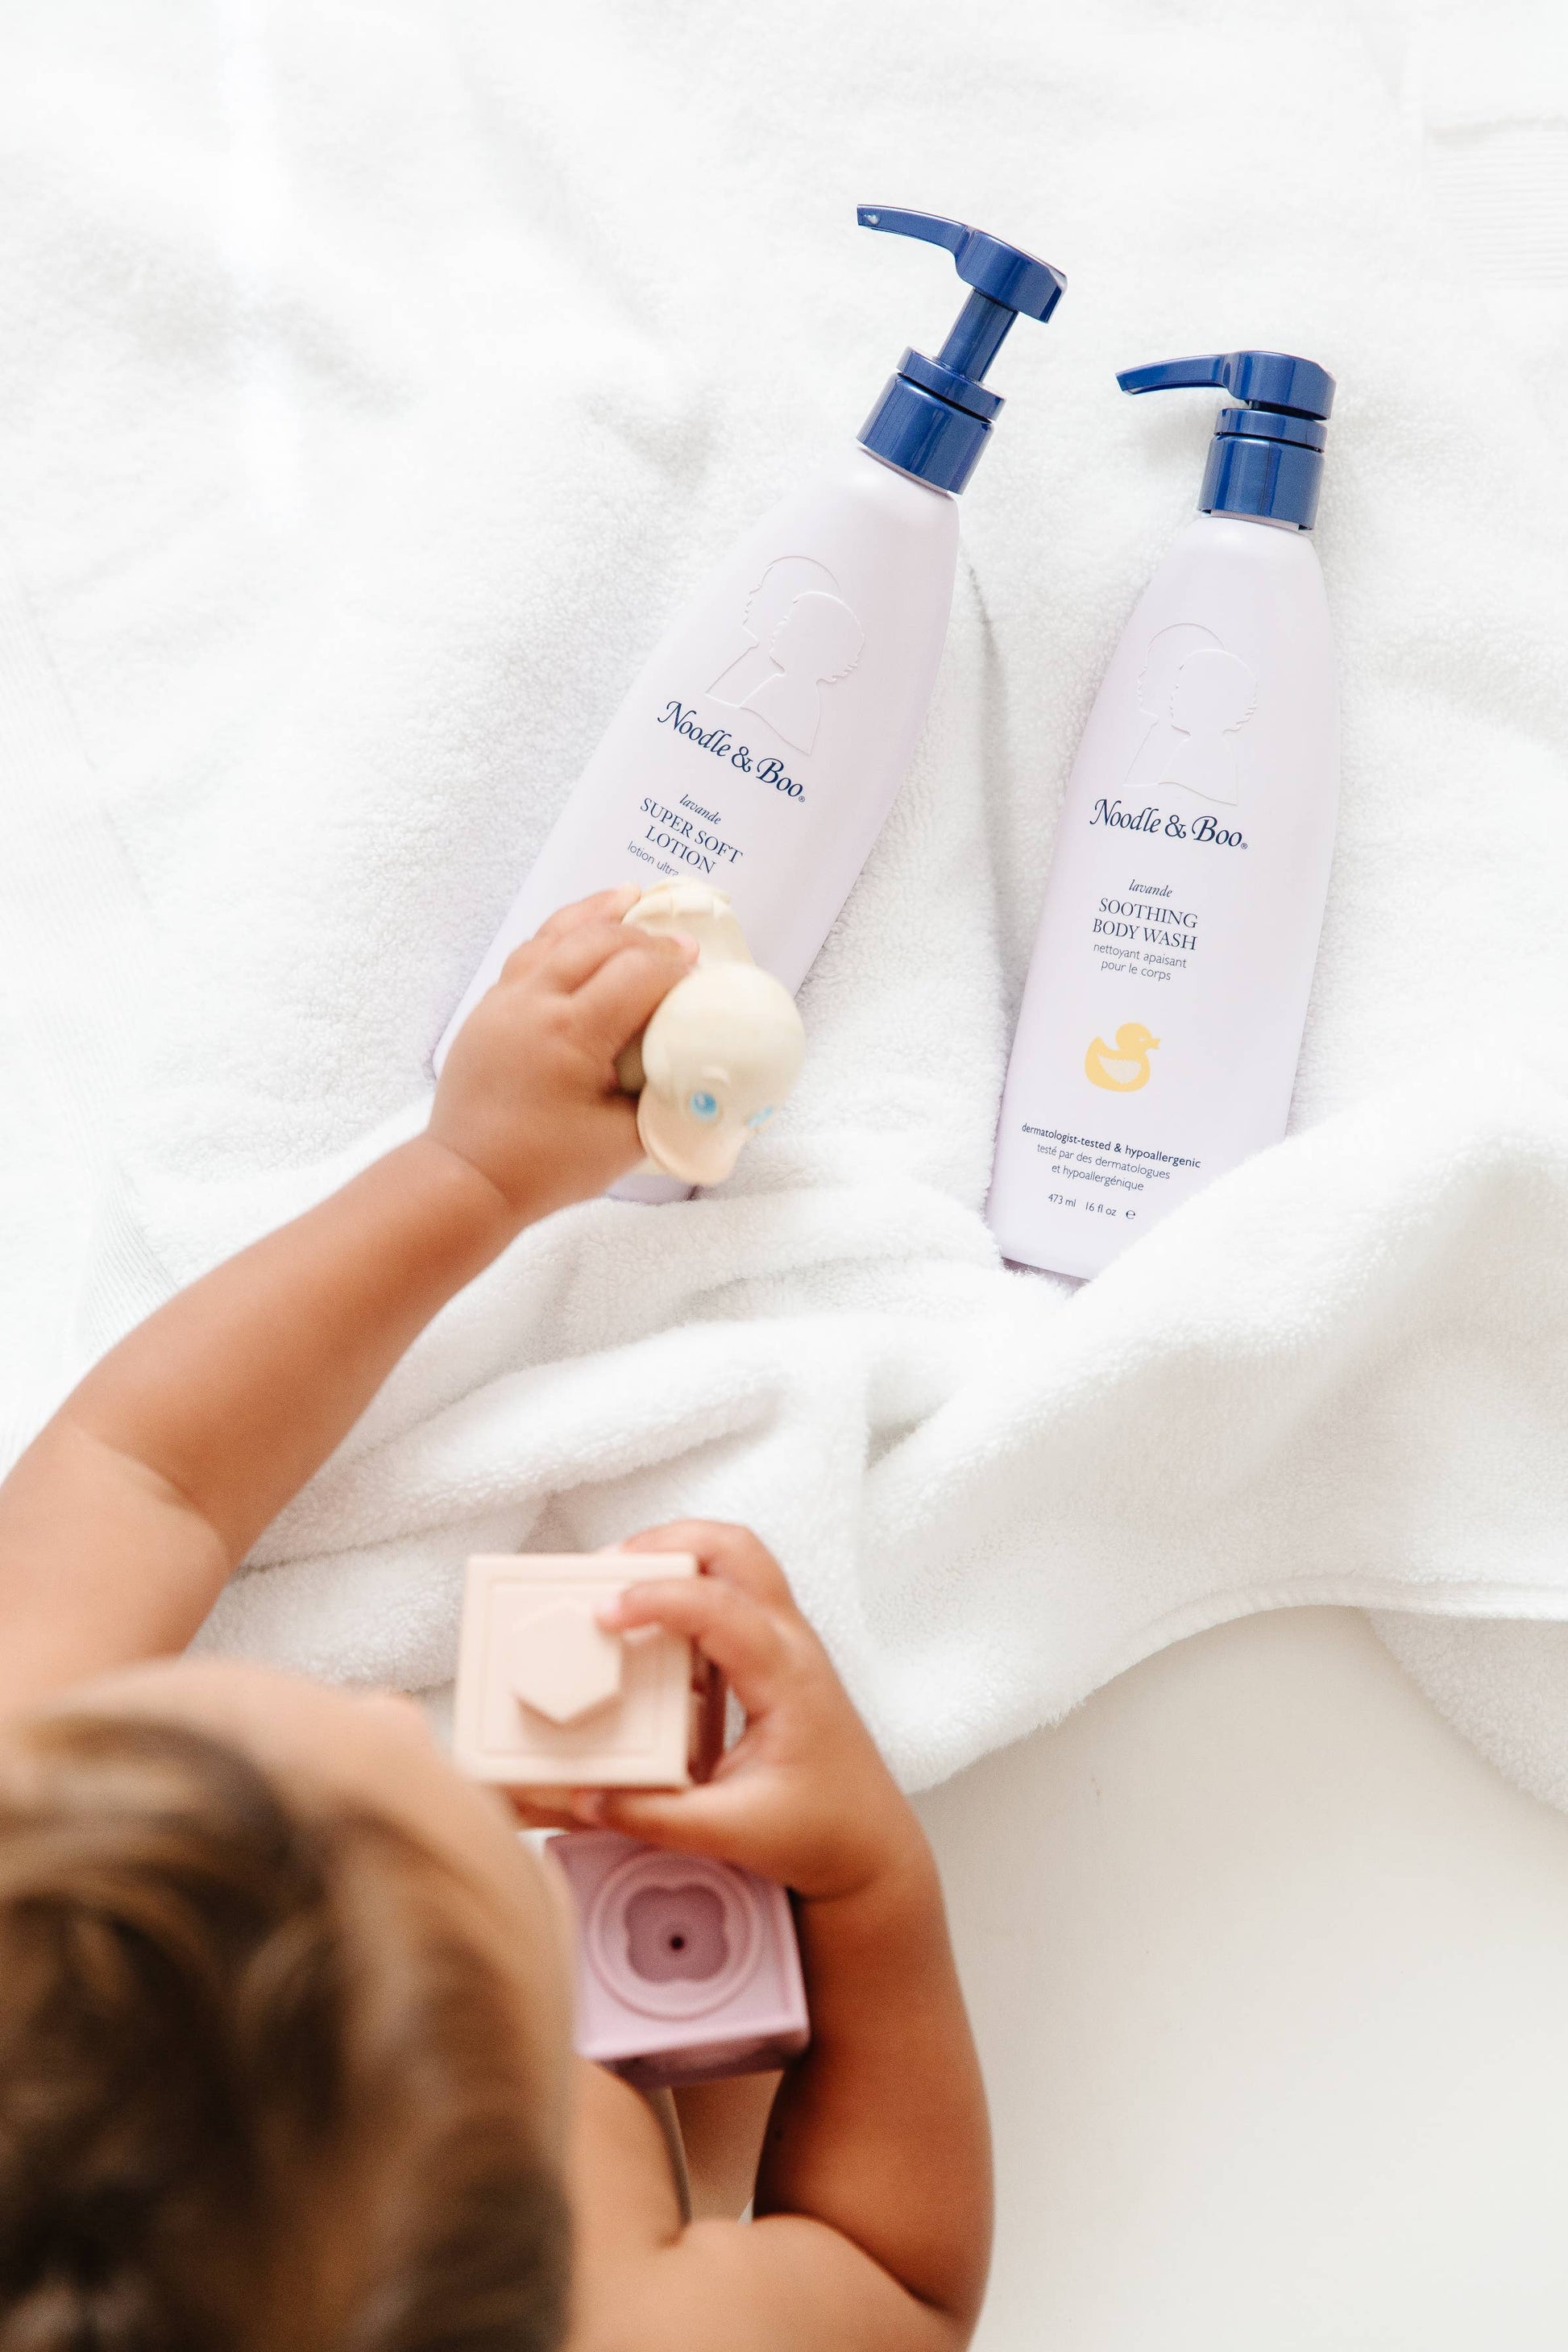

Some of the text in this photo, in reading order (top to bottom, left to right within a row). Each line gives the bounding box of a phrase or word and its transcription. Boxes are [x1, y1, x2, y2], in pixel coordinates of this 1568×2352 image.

[657, 701, 732, 757] Noodle
[732, 746, 753, 773] &
[679, 794, 721, 824] lavande
[1089, 799, 1161, 833] Noodle
[1165, 815, 1186, 839] &
[640, 798, 743, 864] SUPER SOFT
[628, 840, 654, 865] lotion
[645, 826, 717, 874] LOTION
[1129, 879, 1173, 898] lavande
[1099, 898, 1198, 928] SOOTHING
[1093, 919, 1197, 950] BODY WASH
[1093, 944, 1187, 969] nettoyant apaisant
[1101, 961, 1171, 981] pour le corps
[1022, 1123, 1201, 1168] dermatologist-tested & hypoallergenic
[1037, 1144, 1171, 1180] testé par des dermatologues
[1052, 1165, 1144, 1191] et hypoallergénique
[1047, 1193, 1064, 1204] 473
[1065, 1197, 1076, 1207] ml
[1086, 1202, 1094, 1212] 16
[1097, 1205, 1103, 1213] fl
[1105, 1208, 1117, 1216] oz
